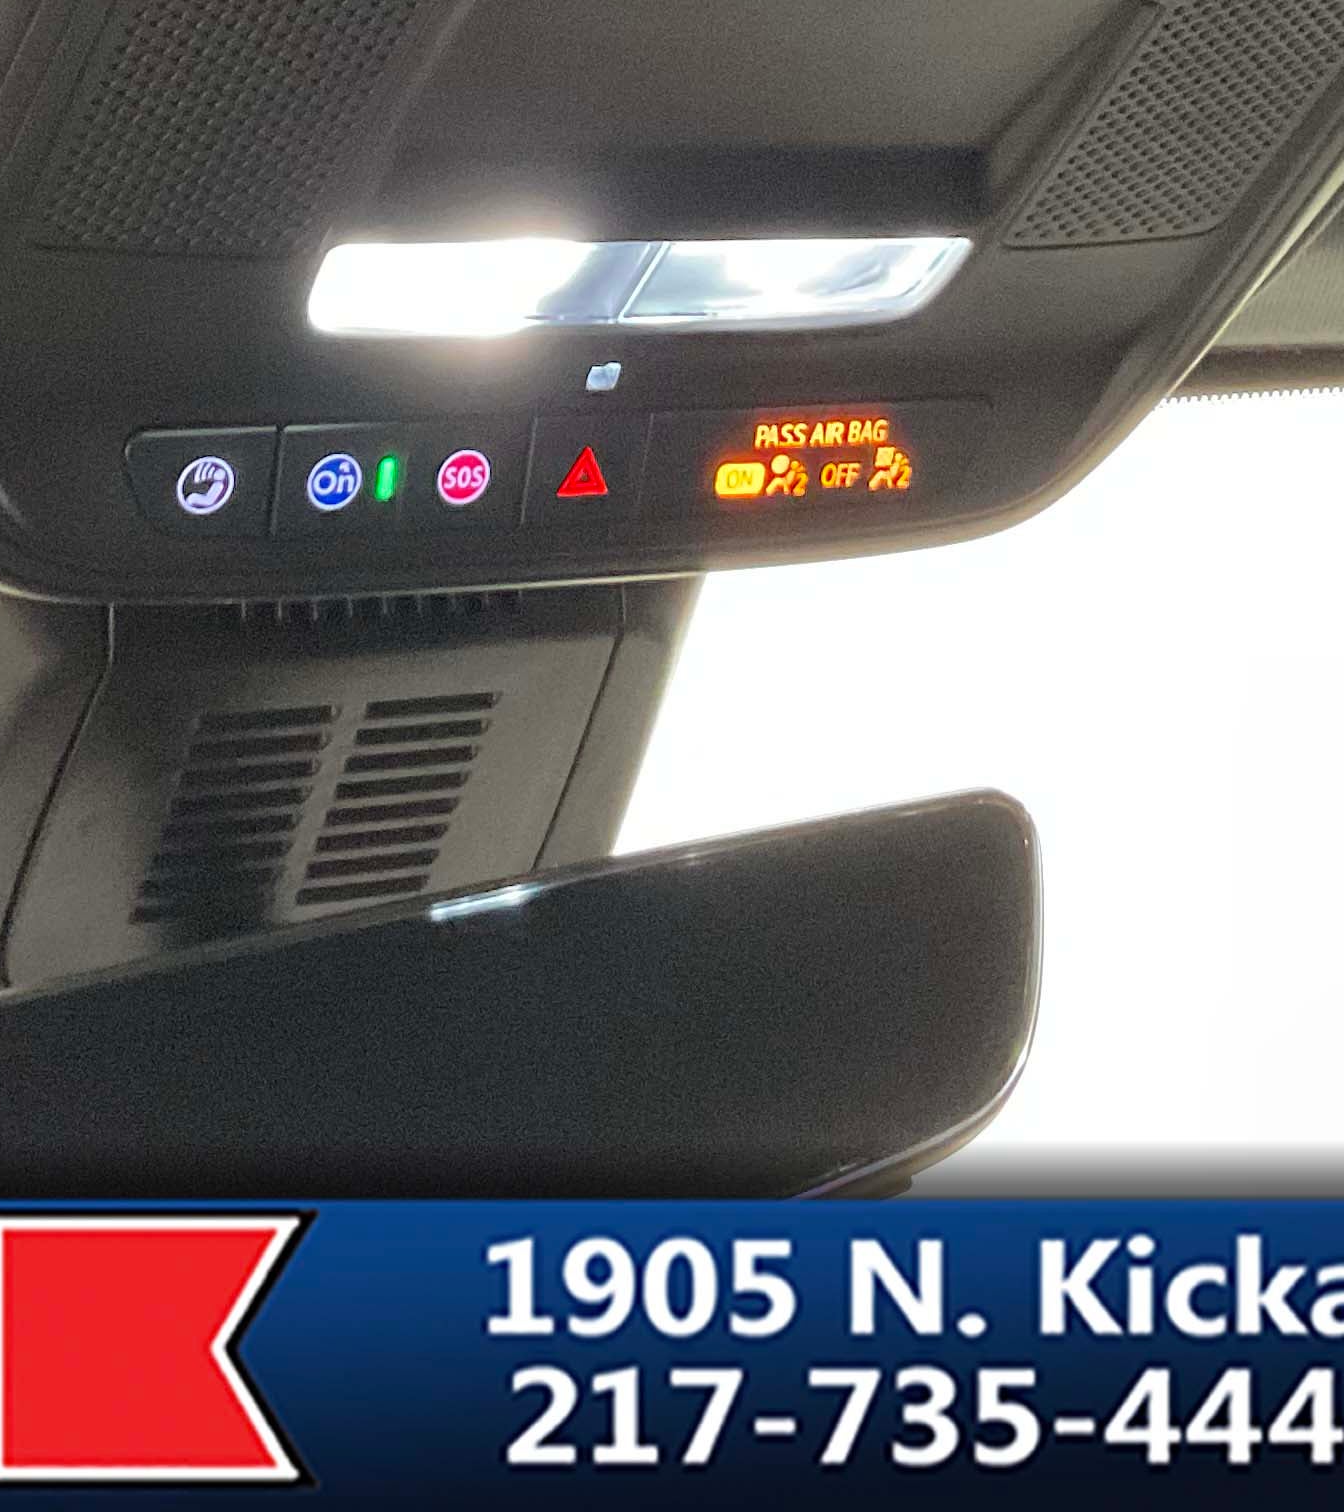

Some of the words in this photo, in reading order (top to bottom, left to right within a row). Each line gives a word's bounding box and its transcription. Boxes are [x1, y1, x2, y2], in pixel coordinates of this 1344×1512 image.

[755, 422, 808, 448] PASS
[809, 421, 845, 447] AIR
[847, 418, 889, 443] BAG
[313, 464, 355, 495] On
[443, 465, 484, 491] SOS
[726, 469, 753, 489] ON
[820, 461, 862, 488] OFF
